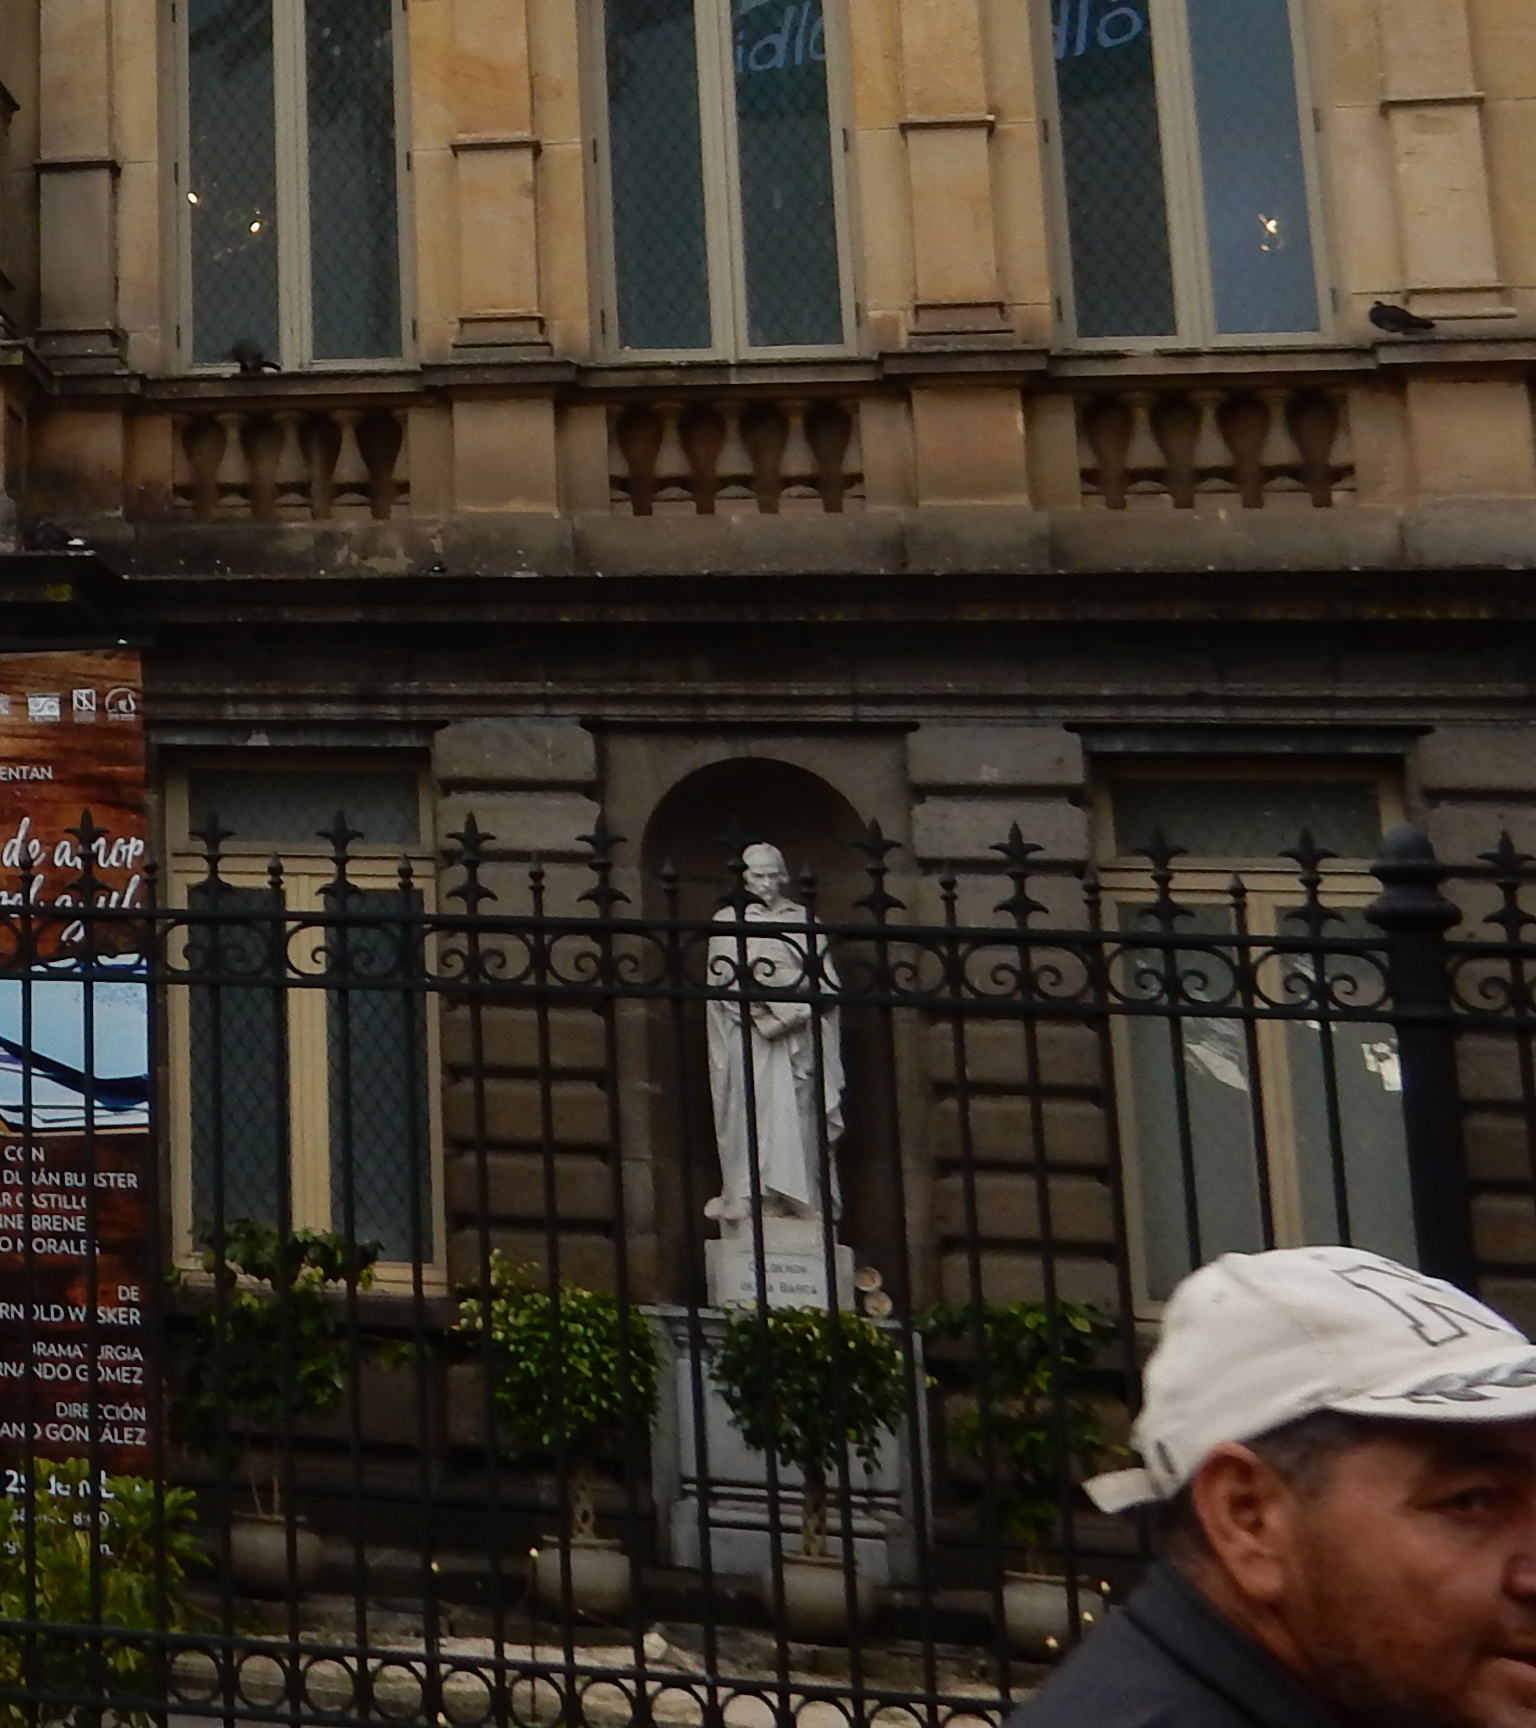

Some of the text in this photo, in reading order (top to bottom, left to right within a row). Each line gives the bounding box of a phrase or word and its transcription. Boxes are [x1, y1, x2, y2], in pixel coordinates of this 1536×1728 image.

[117, 1285, 141, 1302] DE
[68, 1305, 141, 1326] WSKER
[55, 1401, 146, 1422] DIRECIÓN
[45, 1422, 147, 1446] GONÁLEZ
